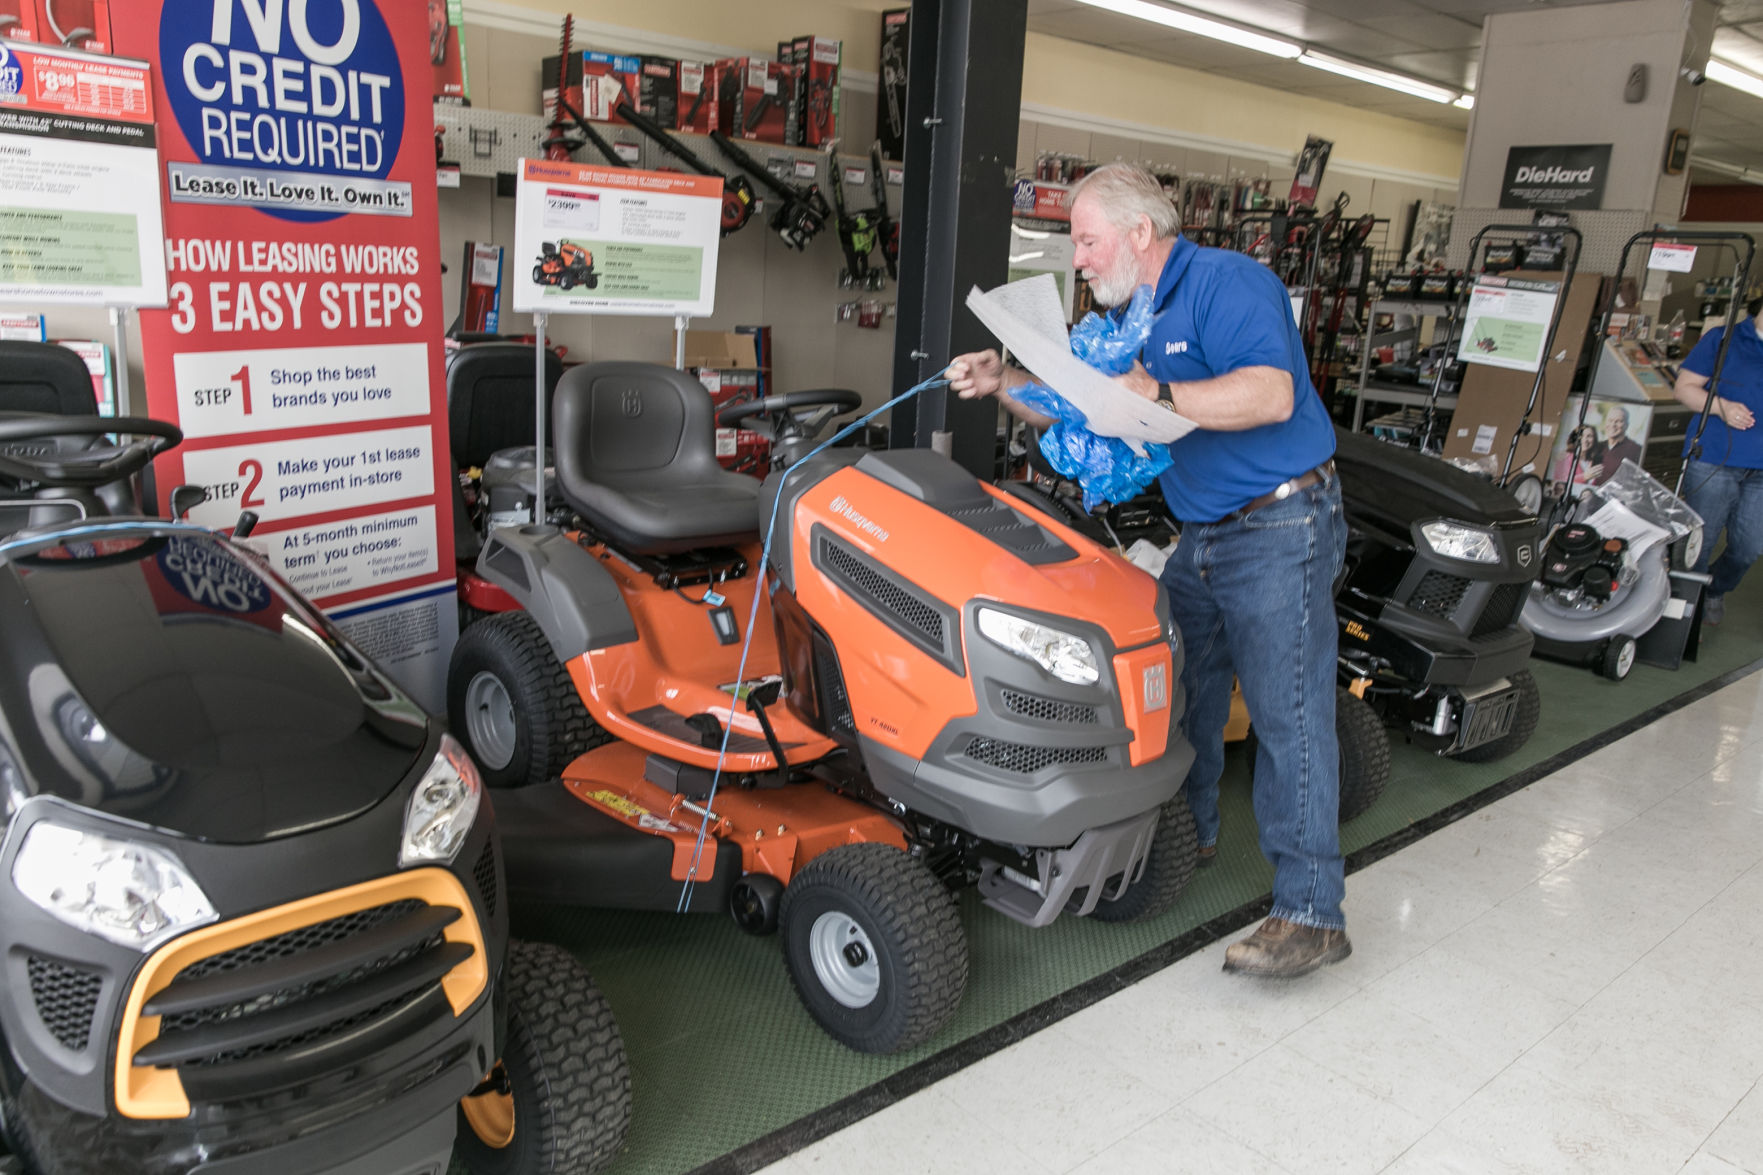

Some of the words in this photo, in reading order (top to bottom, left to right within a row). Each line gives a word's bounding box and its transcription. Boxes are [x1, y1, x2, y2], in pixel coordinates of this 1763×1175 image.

[210, 0, 361, 66] NO
[182, 42, 391, 124] CREDIT
[201, 106, 385, 172] REQUIRED
[174, 173, 237, 194] Lease
[243, 179, 264, 197] It.
[269, 182, 315, 202] Love
[320, 186, 339, 203] It.
[344, 188, 383, 205] Own
[1514, 165, 1595, 183] DieHard
[166, 238, 232, 272] HOW
[237, 240, 337, 274] LEASING
[341, 244, 419, 275] WORKS
[170, 281, 196, 334] 3
[209, 281, 307, 332] EASY
[319, 281, 423, 330] STEPS
[194, 387, 232, 407] STEP
[230, 364, 253, 416] 1
[270, 369, 312, 387] Shop
[317, 366, 341, 382] the
[345, 364, 376, 380] best
[272, 391, 327, 408] brands
[331, 391, 358, 407] you
[362, 386, 392, 402] love
[277, 460, 318, 477] Make
[323, 455, 356, 477] your
[361, 450, 382, 466] 1st
[385, 446, 421, 462] lease
[203, 481, 239, 503] STEP
[238, 458, 265, 510] 2
[279, 476, 345, 502] payment
[349, 469, 402, 489] in-store
[284, 535, 299, 550] At
[302, 524, 358, 546] 5-month
[361, 515, 418, 535] minimum
[324, 547, 349, 564] you
[352, 536, 402, 554] choose:
